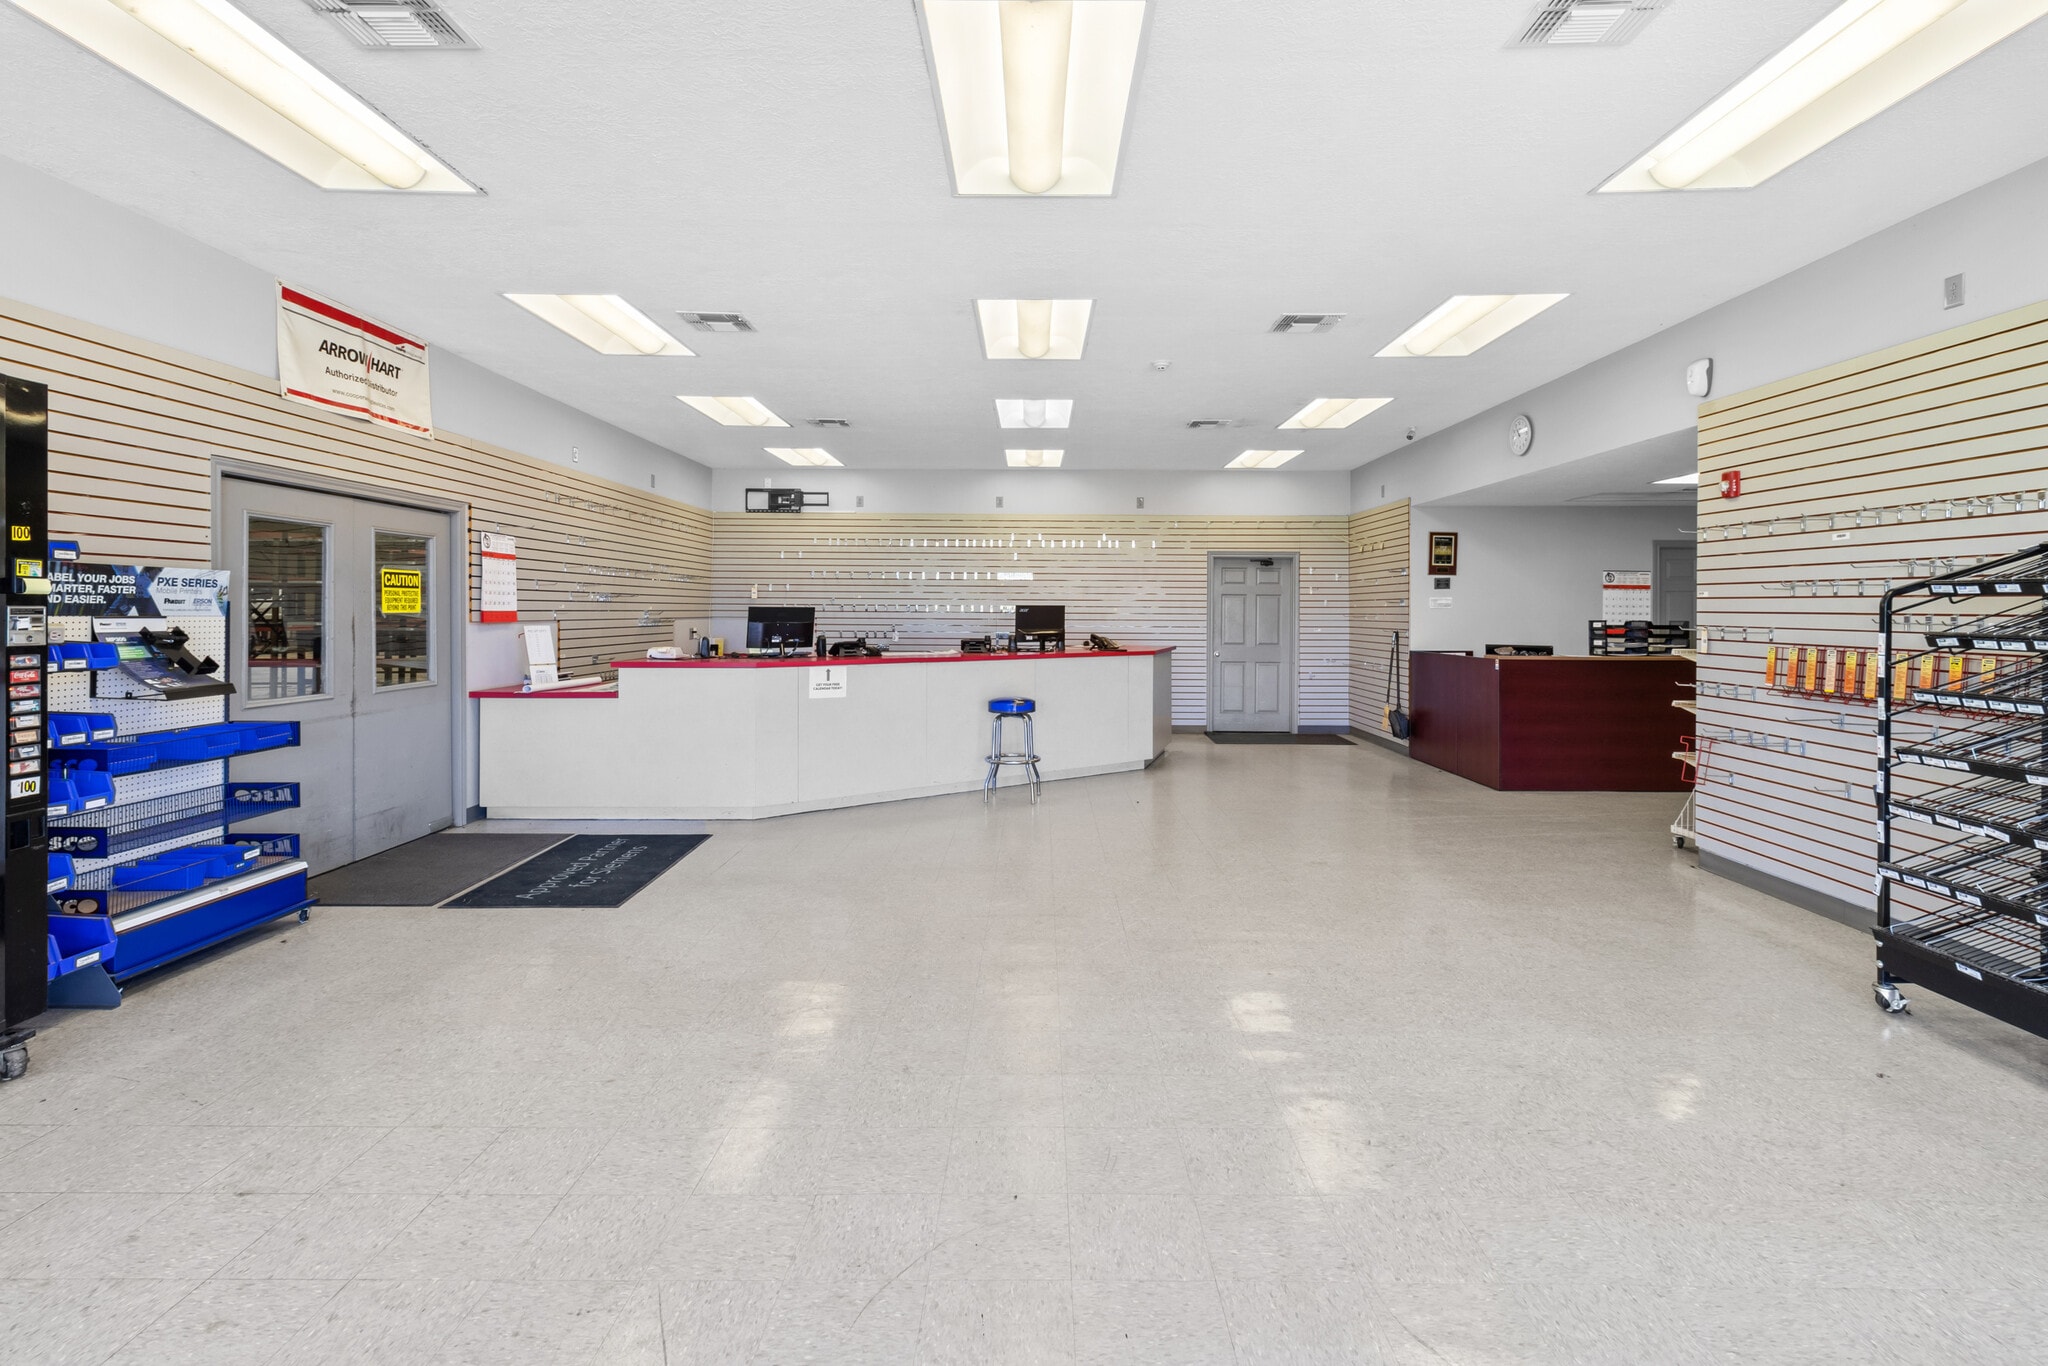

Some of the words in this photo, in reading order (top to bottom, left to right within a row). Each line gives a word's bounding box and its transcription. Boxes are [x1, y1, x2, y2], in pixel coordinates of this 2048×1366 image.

[318, 339, 369, 367] ARROW
[371, 357, 402, 379] HART
[13, 526, 30, 539] 100
[47, 572, 75, 582] ABEL
[77, 573, 107, 583] YOUR
[109, 575, 136, 584] JOBS
[157, 577, 179, 587] PXE
[181, 578, 219, 588] SERIES
[384, 573, 419, 587] CAUTION
[97, 585, 136, 595] FASTER
[47, 595, 62, 604] ND
[64, 595, 107, 604] EASIER.
[20, 780, 36, 793] 100
[515, 862, 591, 900] Approved
[578, 837, 630, 861] Partner
[568, 875, 601, 888] for
[589, 845, 648, 875] Siemens
